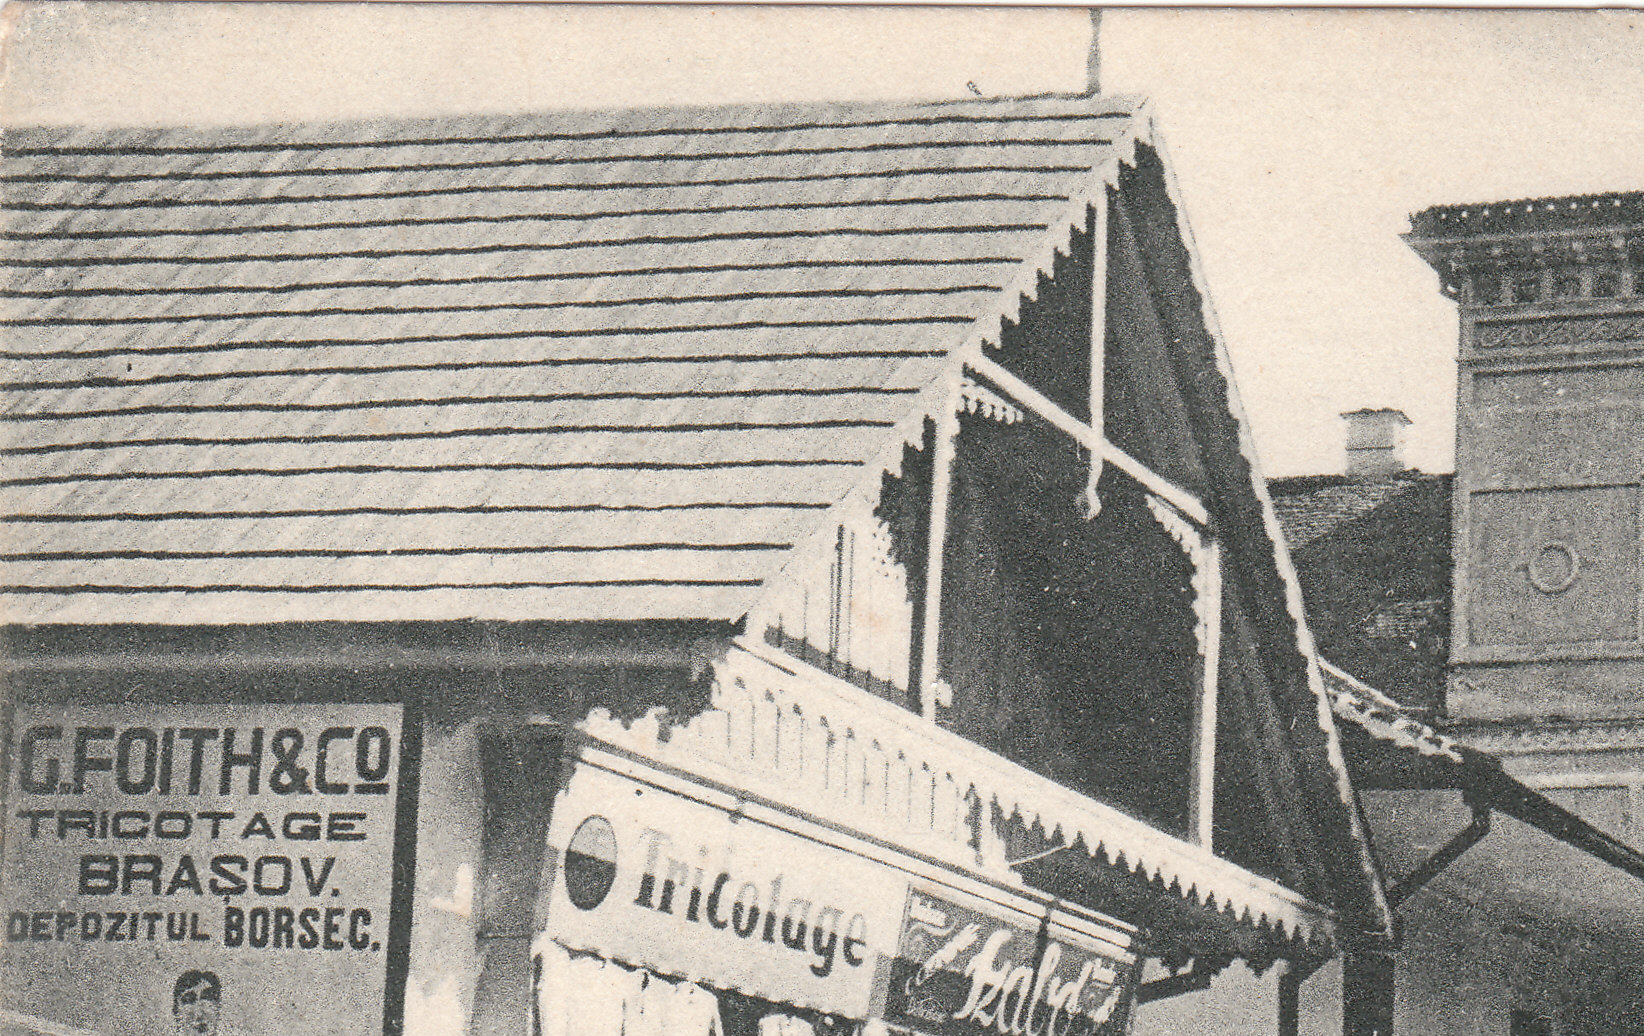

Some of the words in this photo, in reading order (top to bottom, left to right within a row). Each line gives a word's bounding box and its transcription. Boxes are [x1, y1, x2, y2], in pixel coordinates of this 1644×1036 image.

[15, 809, 368, 843] TRICOTAGE
[6, 911, 211, 943] DEPOZITUL
[223, 906, 382, 952] BORSEC.
